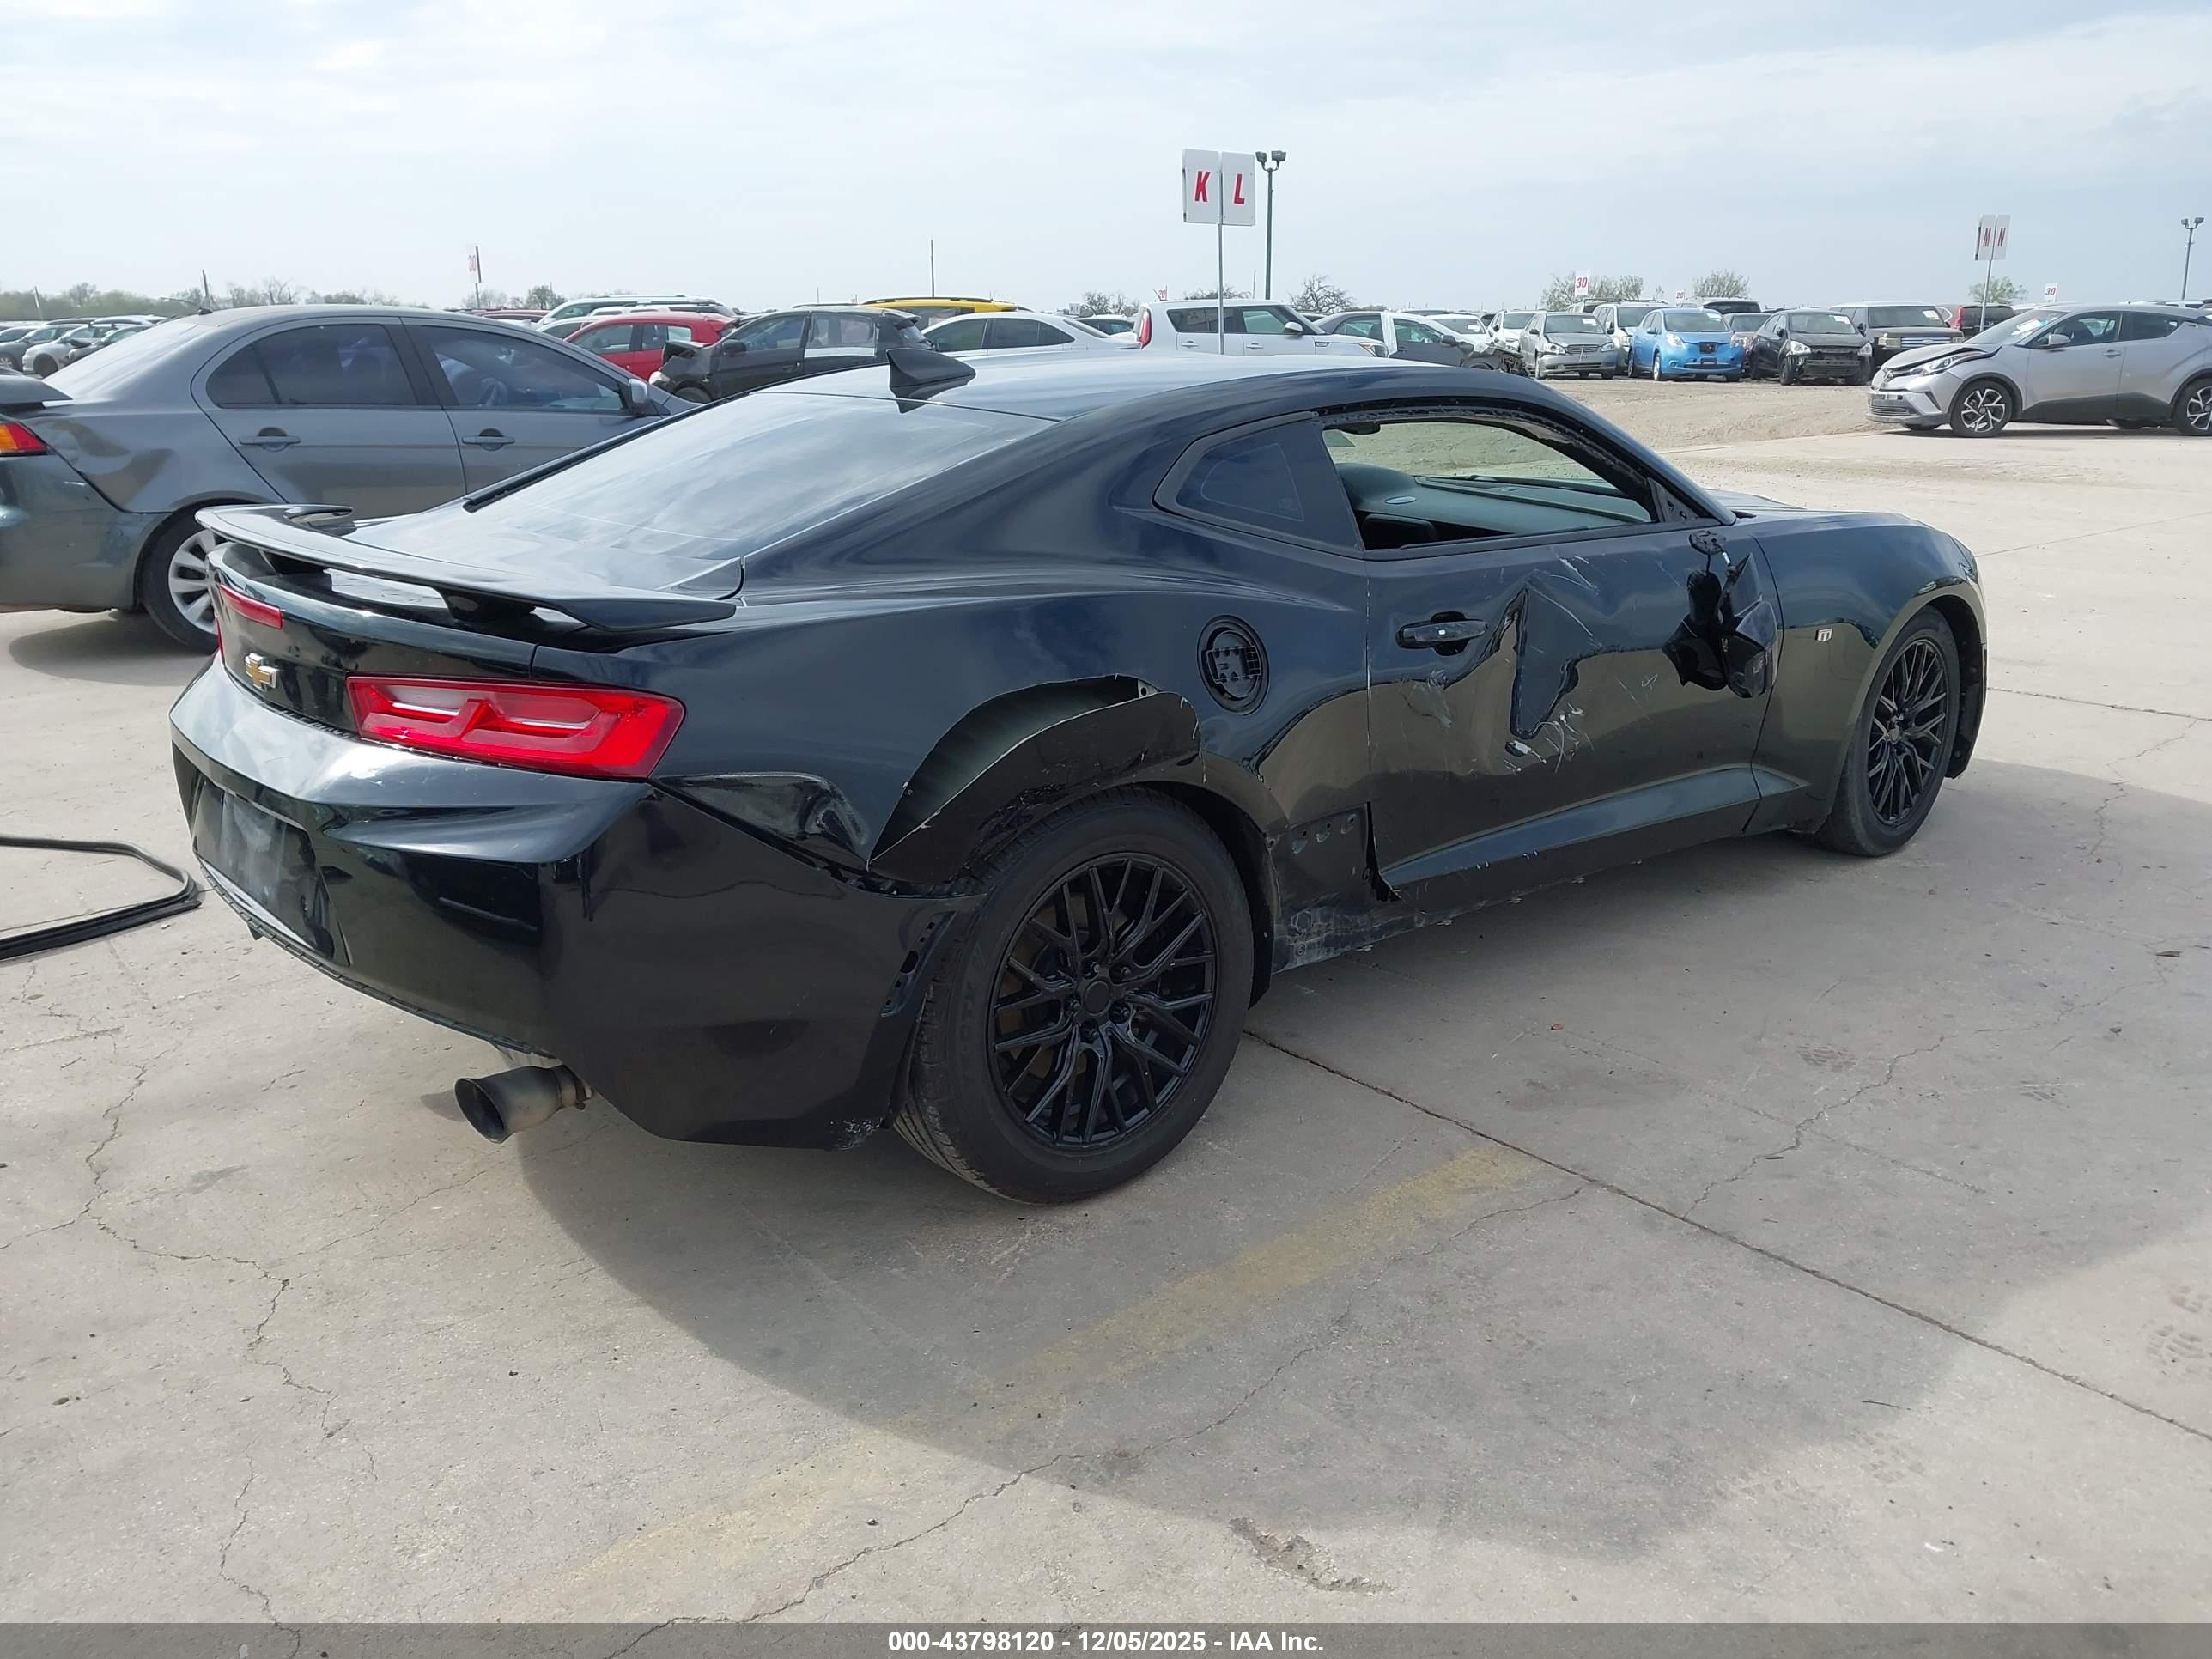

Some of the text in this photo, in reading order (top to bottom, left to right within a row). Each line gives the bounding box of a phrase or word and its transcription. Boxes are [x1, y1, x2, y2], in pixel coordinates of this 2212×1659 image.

[1194, 170, 1245, 205] K L
[1982, 227, 2007, 248] M N
[1576, 276, 1588, 289] 30
[2045, 287, 2057, 296] 30
